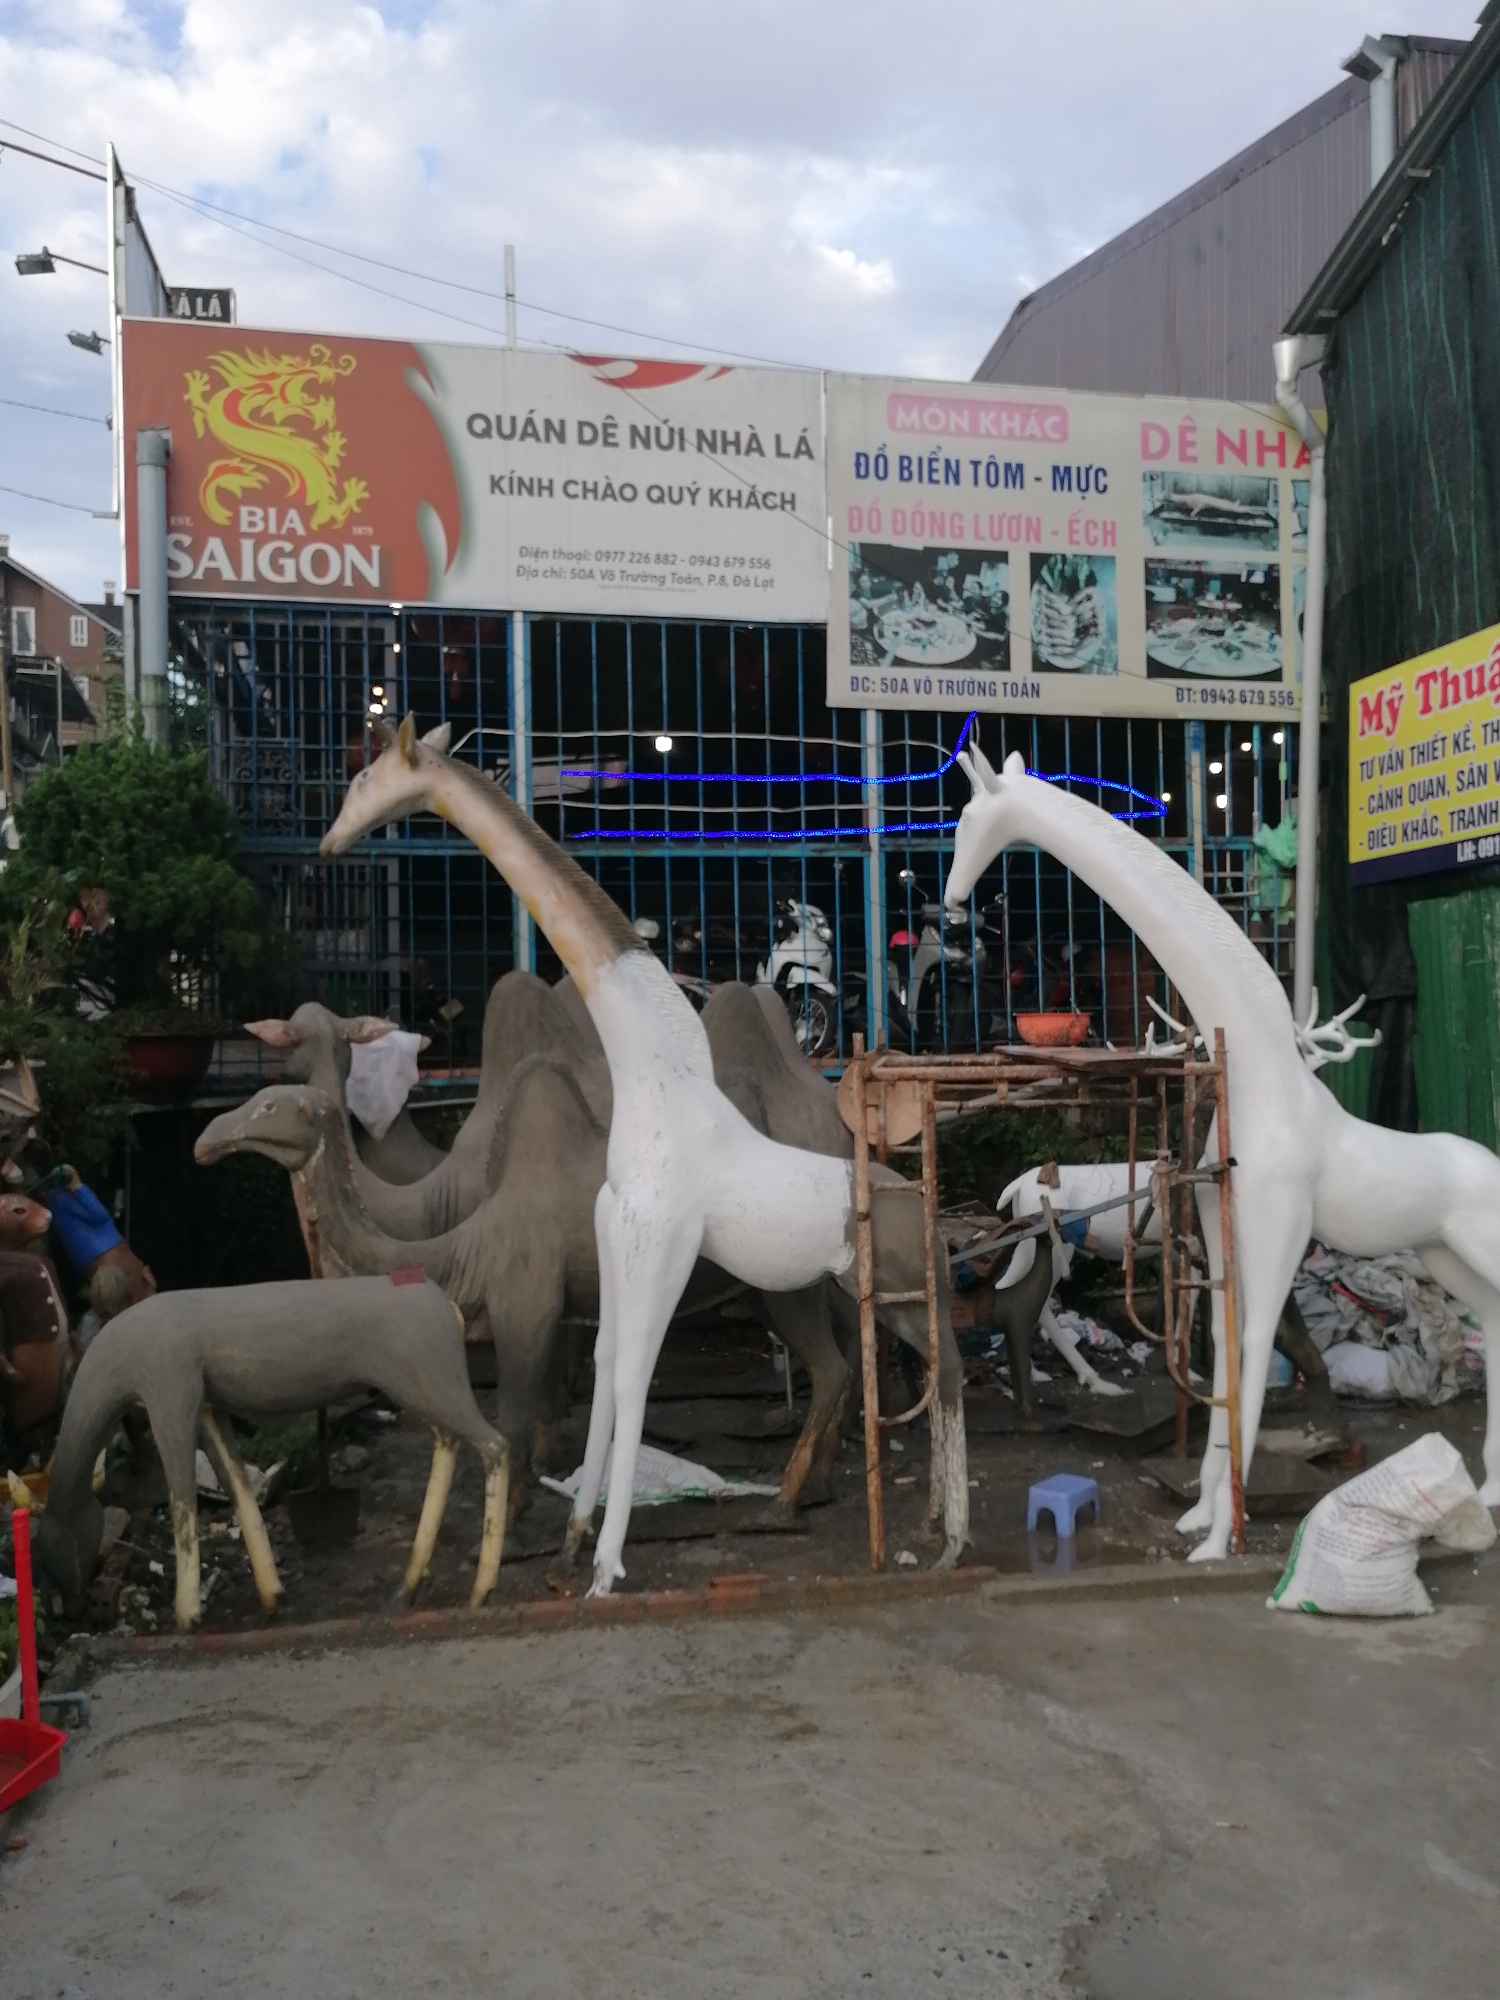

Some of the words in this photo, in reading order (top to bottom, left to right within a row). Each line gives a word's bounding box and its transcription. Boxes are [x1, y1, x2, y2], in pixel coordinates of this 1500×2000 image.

[466, 409, 567, 445] QUÁN
[577, 415, 621, 449] DÊ
[629, 418, 686, 452] NÚI
[695, 424, 767, 458] NHÀ
[774, 427, 815, 461] LÁ
[896, 402, 970, 434] MÓN
[978, 408, 1064, 441] KHÁC
[1141, 414, 1199, 464] DÊ
[489, 470, 554, 499] KÍNH
[562, 475, 639, 503] CHÀO
[645, 480, 701, 507] QUÝ
[708, 483, 797, 512] KHÁCH
[899, 445, 961, 487] BIỂN
[970, 455, 1025, 490] TÔM
[1052, 463, 1109, 500] MỰC
[239, 504, 307, 537] BIA
[974, 511, 1042, 545] LƯƠN
[1067, 509, 1117, 548] ẾCH
[167, 532, 381, 588] SAIGON
[594, 550, 625, 563] 0977
[628, 552, 651, 564] 226
[653, 553, 678, 566] 882
[688, 555, 720, 567] 0943
[723, 556, 745, 568] 679
[748, 557, 771, 570] 556
[570, 568, 594, 581] 50A
[753, 576, 775, 592] Lạt
[850, 676, 876, 694] ĐC:
[880, 677, 909, 695] 50A
[913, 676, 932, 696] VÕ
[937, 676, 998, 698] TRƯỜNG
[1002, 677, 1041, 699] TOẢN
[1176, 686, 1197, 703] ĐT:
[1201, 687, 1235, 705] 0943
[1240, 690, 1265, 705] 679
[1269, 690, 1294, 706] 556
[1359, 683, 1404, 737] Mỹ
[1410, 730, 1448, 767] THIẾT
[1408, 774, 1450, 806] QUAN,
[1456, 761, 1487, 793] SÂN
[1449, 800, 1499, 833] TRANH
